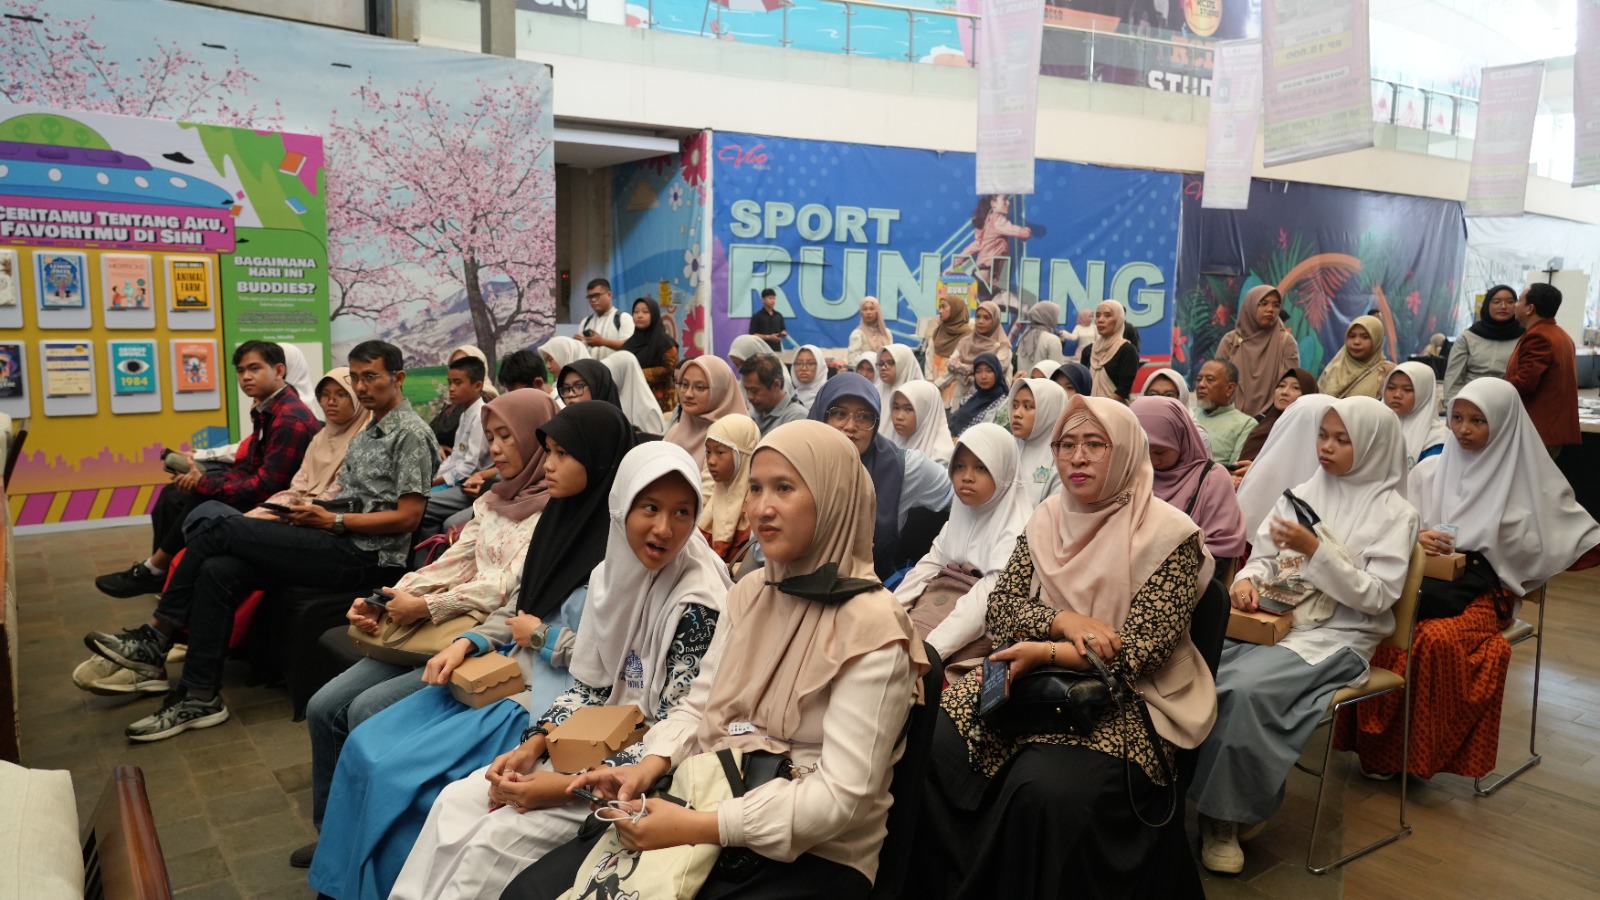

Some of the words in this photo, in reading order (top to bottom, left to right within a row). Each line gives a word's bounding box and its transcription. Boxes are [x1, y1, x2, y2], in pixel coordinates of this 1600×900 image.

[97, 211, 179, 228] TENTANG
[184, 216, 227, 233] AKU,
[729, 199, 900, 245] SPORT
[1, 221, 129, 241] FAVORITMU
[161, 230, 203, 244] SINI
[234, 256, 316, 268] BAGAIMANA
[177, 272, 204, 281] ANIMAL
[249, 267, 281, 277] HARI
[284, 268, 304, 278] INI
[180, 283, 201, 292] FARM
[237, 281, 316, 294] BUDDIES?
[947, 286, 968, 295] BUKU
[120, 376, 149, 387] 1984
